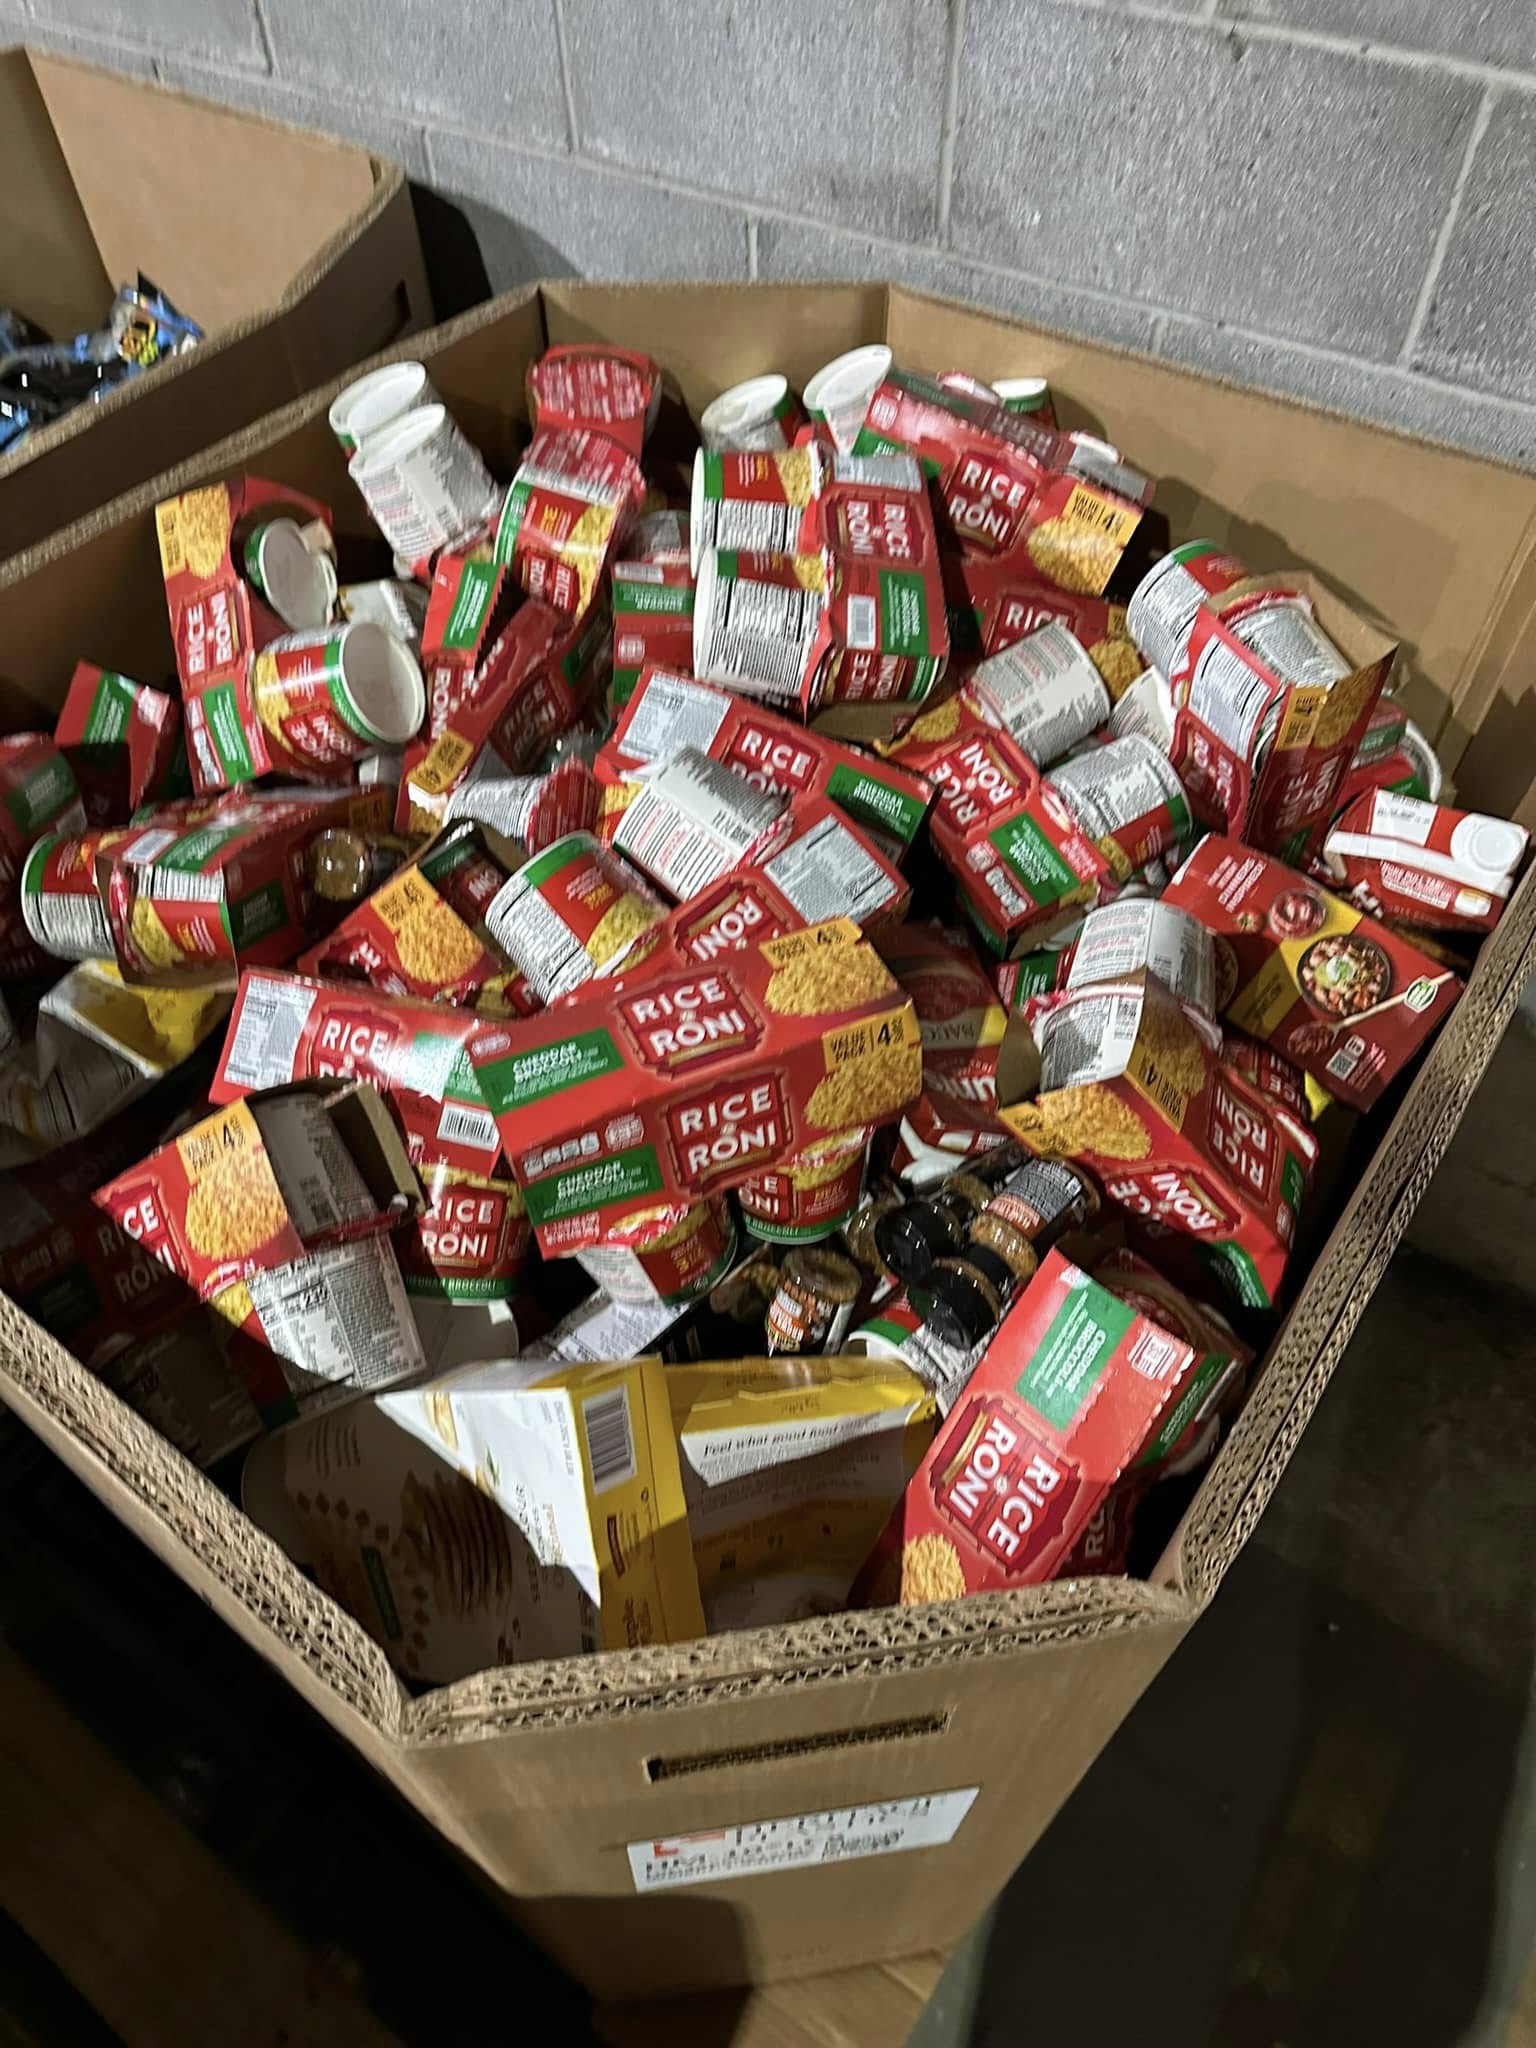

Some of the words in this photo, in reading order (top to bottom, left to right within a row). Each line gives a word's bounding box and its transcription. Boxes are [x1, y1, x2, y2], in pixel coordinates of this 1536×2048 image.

[961, 458, 1027, 510] RICE
[847, 500, 873, 554] RONI
[884, 503, 911, 559] RICE
[949, 494, 1010, 543] RONI
[1103, 504, 1116, 527] 4
[554, 565, 571, 610] RICE
[186, 602, 206, 676] RICE
[211, 590, 234, 666] RONI
[845, 653, 871, 700] RICE
[874, 654, 900, 699] RONI
[740, 728, 812, 779] RICE
[959, 741, 1013, 805] RONI
[857, 778, 905, 808] CHEDDAR
[927, 760, 980, 826] RICE
[690, 896, 764, 962] RONI
[631, 975, 728, 1026] RICE
[321, 1020, 389, 1060] RICE
[512, 1041, 578, 1075] CHEDDAR
[649, 1008, 747, 1058] RONI
[831, 1031, 866, 1051] VALUE
[877, 1022, 891, 1046] 4
[514, 1052, 584, 1084] BROCCOLI
[222, 1123, 234, 1147] 4
[680, 1083, 773, 1136] RICE
[1216, 1084, 1268, 1152] RONI
[687, 1121, 777, 1176] RONI
[1213, 1120, 1265, 1190] RICE
[557, 1159, 623, 1190] CHEDDAR
[1151, 1170, 1218, 1231] RONI
[421, 1231, 489, 1259] RONI
[447, 1279, 498, 1294] BROCCOLI
[1068, 1330, 1107, 1393] CHEDDAR
[703, 1439, 732, 1458] Feel
[734, 1434, 769, 1453] what
[949, 1416, 1017, 1519] RONI
[988, 1451, 1062, 1556] RICE
